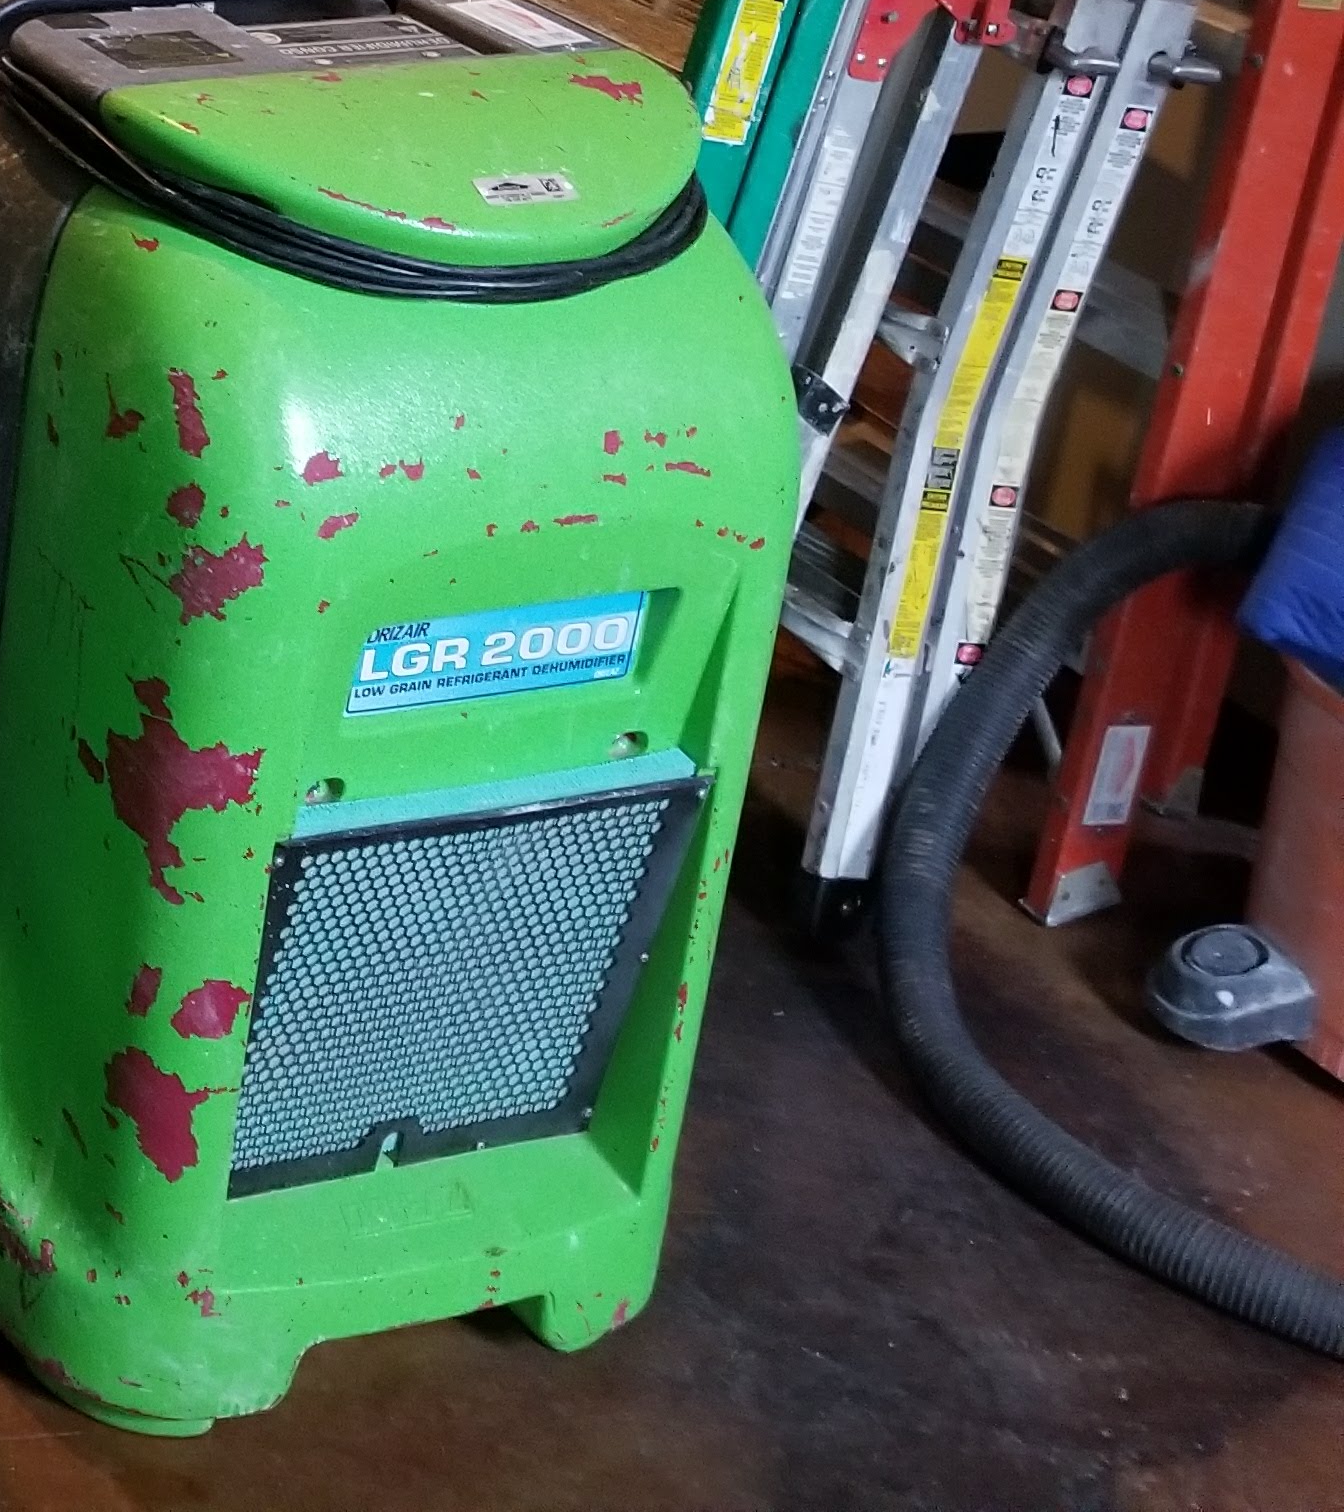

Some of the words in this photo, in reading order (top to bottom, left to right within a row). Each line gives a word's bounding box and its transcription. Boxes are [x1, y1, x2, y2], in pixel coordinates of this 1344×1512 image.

[359, 637, 470, 682] LGR
[480, 617, 629, 667] 2000
[366, 622, 431, 644] DRIZAIR
[354, 685, 385, 699] LOW
[389, 680, 432, 695] GRAIN
[437, 667, 528, 689] REFRIGERANT
[532, 654, 627, 676] DEHUMIDIFIER
